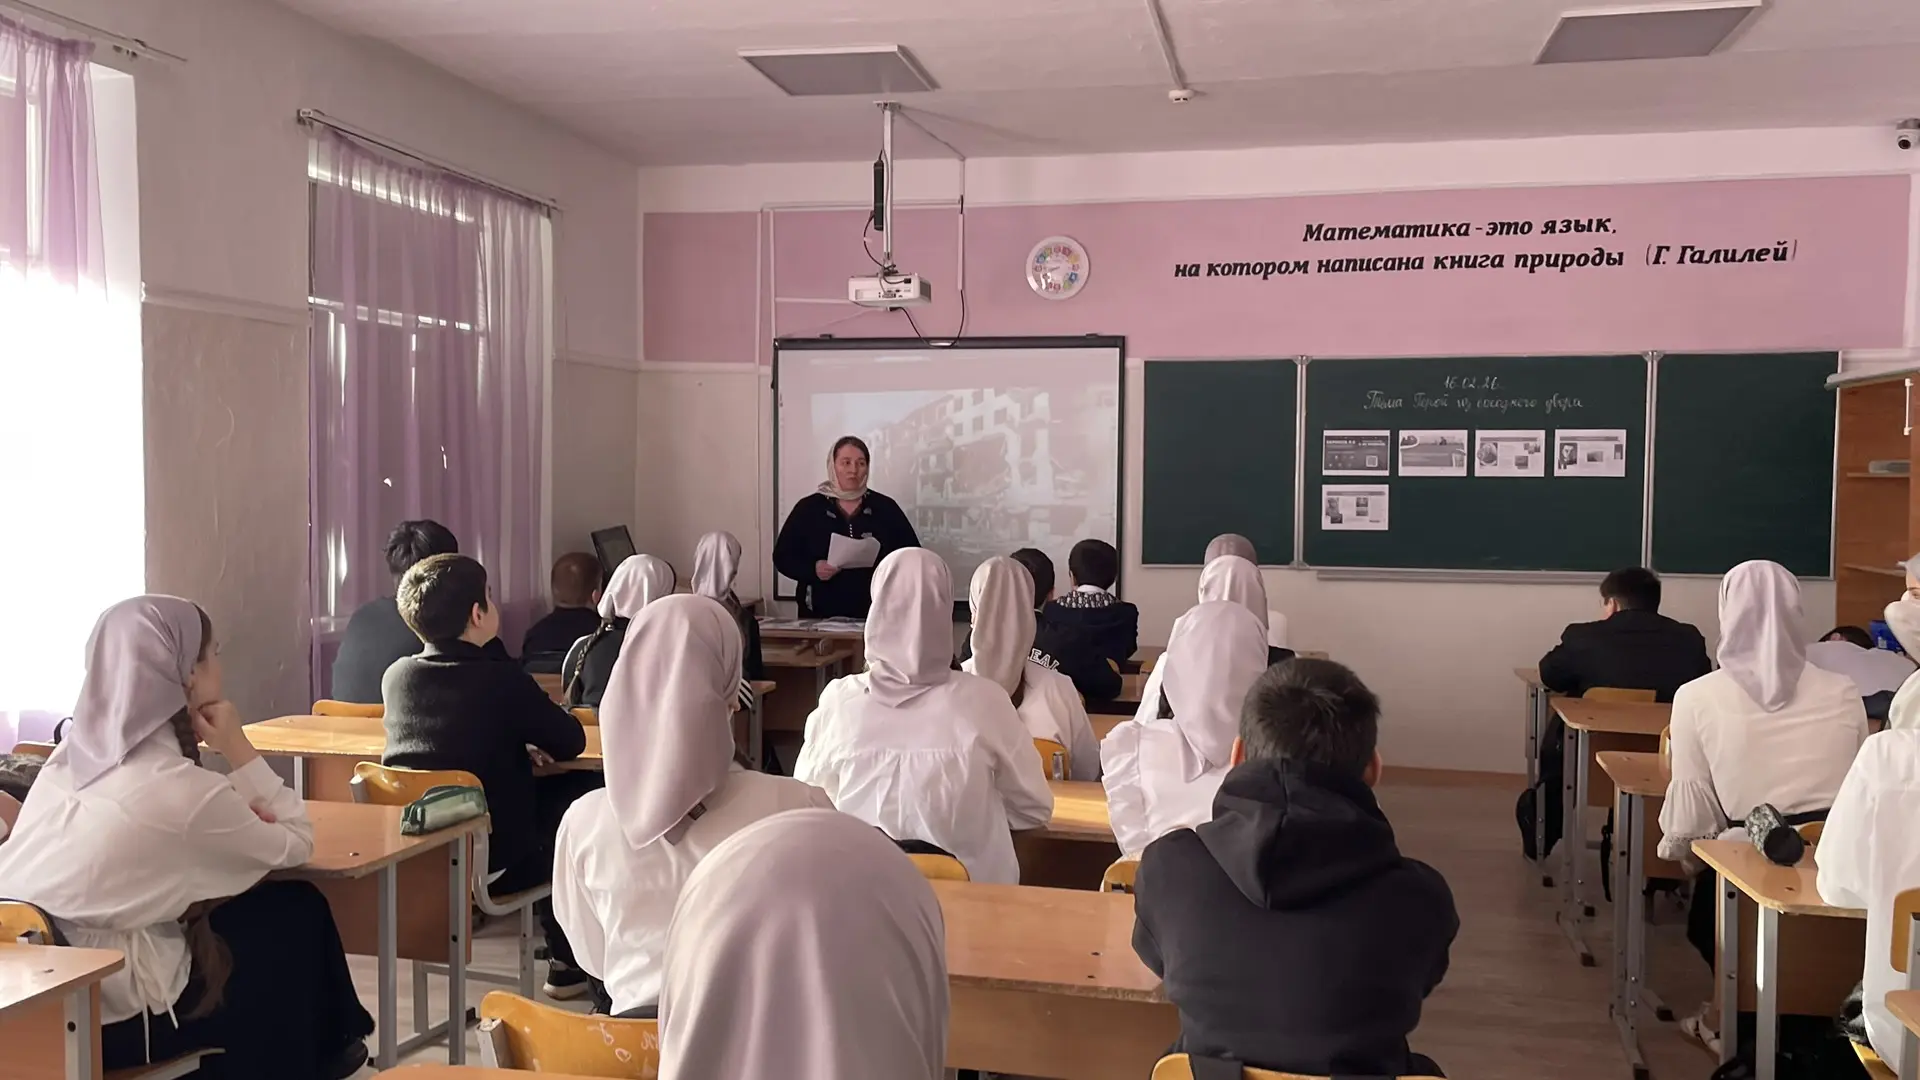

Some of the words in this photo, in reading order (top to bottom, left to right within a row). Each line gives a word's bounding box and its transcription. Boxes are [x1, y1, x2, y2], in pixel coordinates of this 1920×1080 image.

[1302, 222, 1471, 243] Математика
[1485, 220, 1534, 237] это
[1540, 217, 1618, 235] язык,
[1174, 263, 1201, 278] на
[1206, 260, 1310, 281] котором
[1316, 255, 1425, 274] написана
[1433, 253, 1505, 270] книга
[1513, 246, 1625, 274] природы
[1645, 243, 1671, 266] (Г.
[1676, 239, 1798, 265] Галилей)
